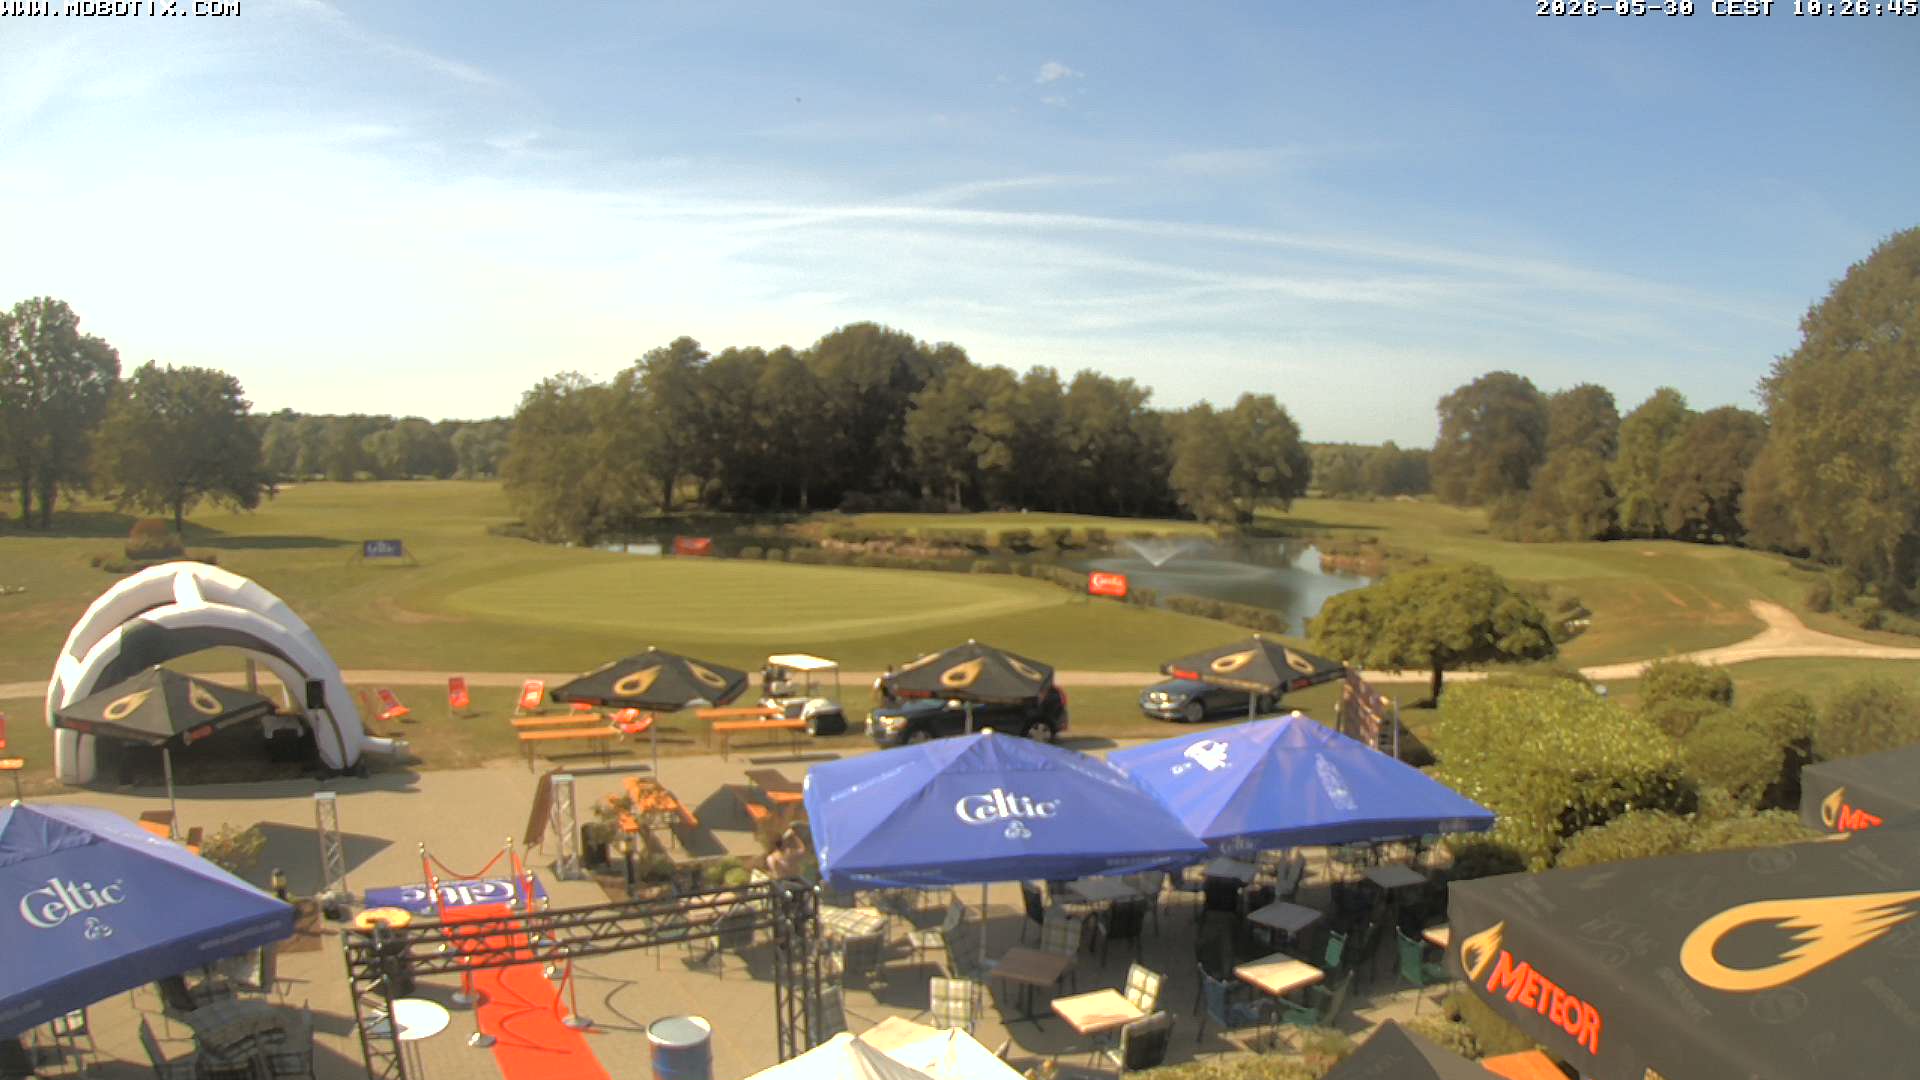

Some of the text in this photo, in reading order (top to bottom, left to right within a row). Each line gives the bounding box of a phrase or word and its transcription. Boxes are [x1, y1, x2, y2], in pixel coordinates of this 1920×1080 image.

[956, 787, 1057, 823] Celtic
[19, 877, 127, 928] Celtic
[1486, 949, 1602, 1056] METEOR
